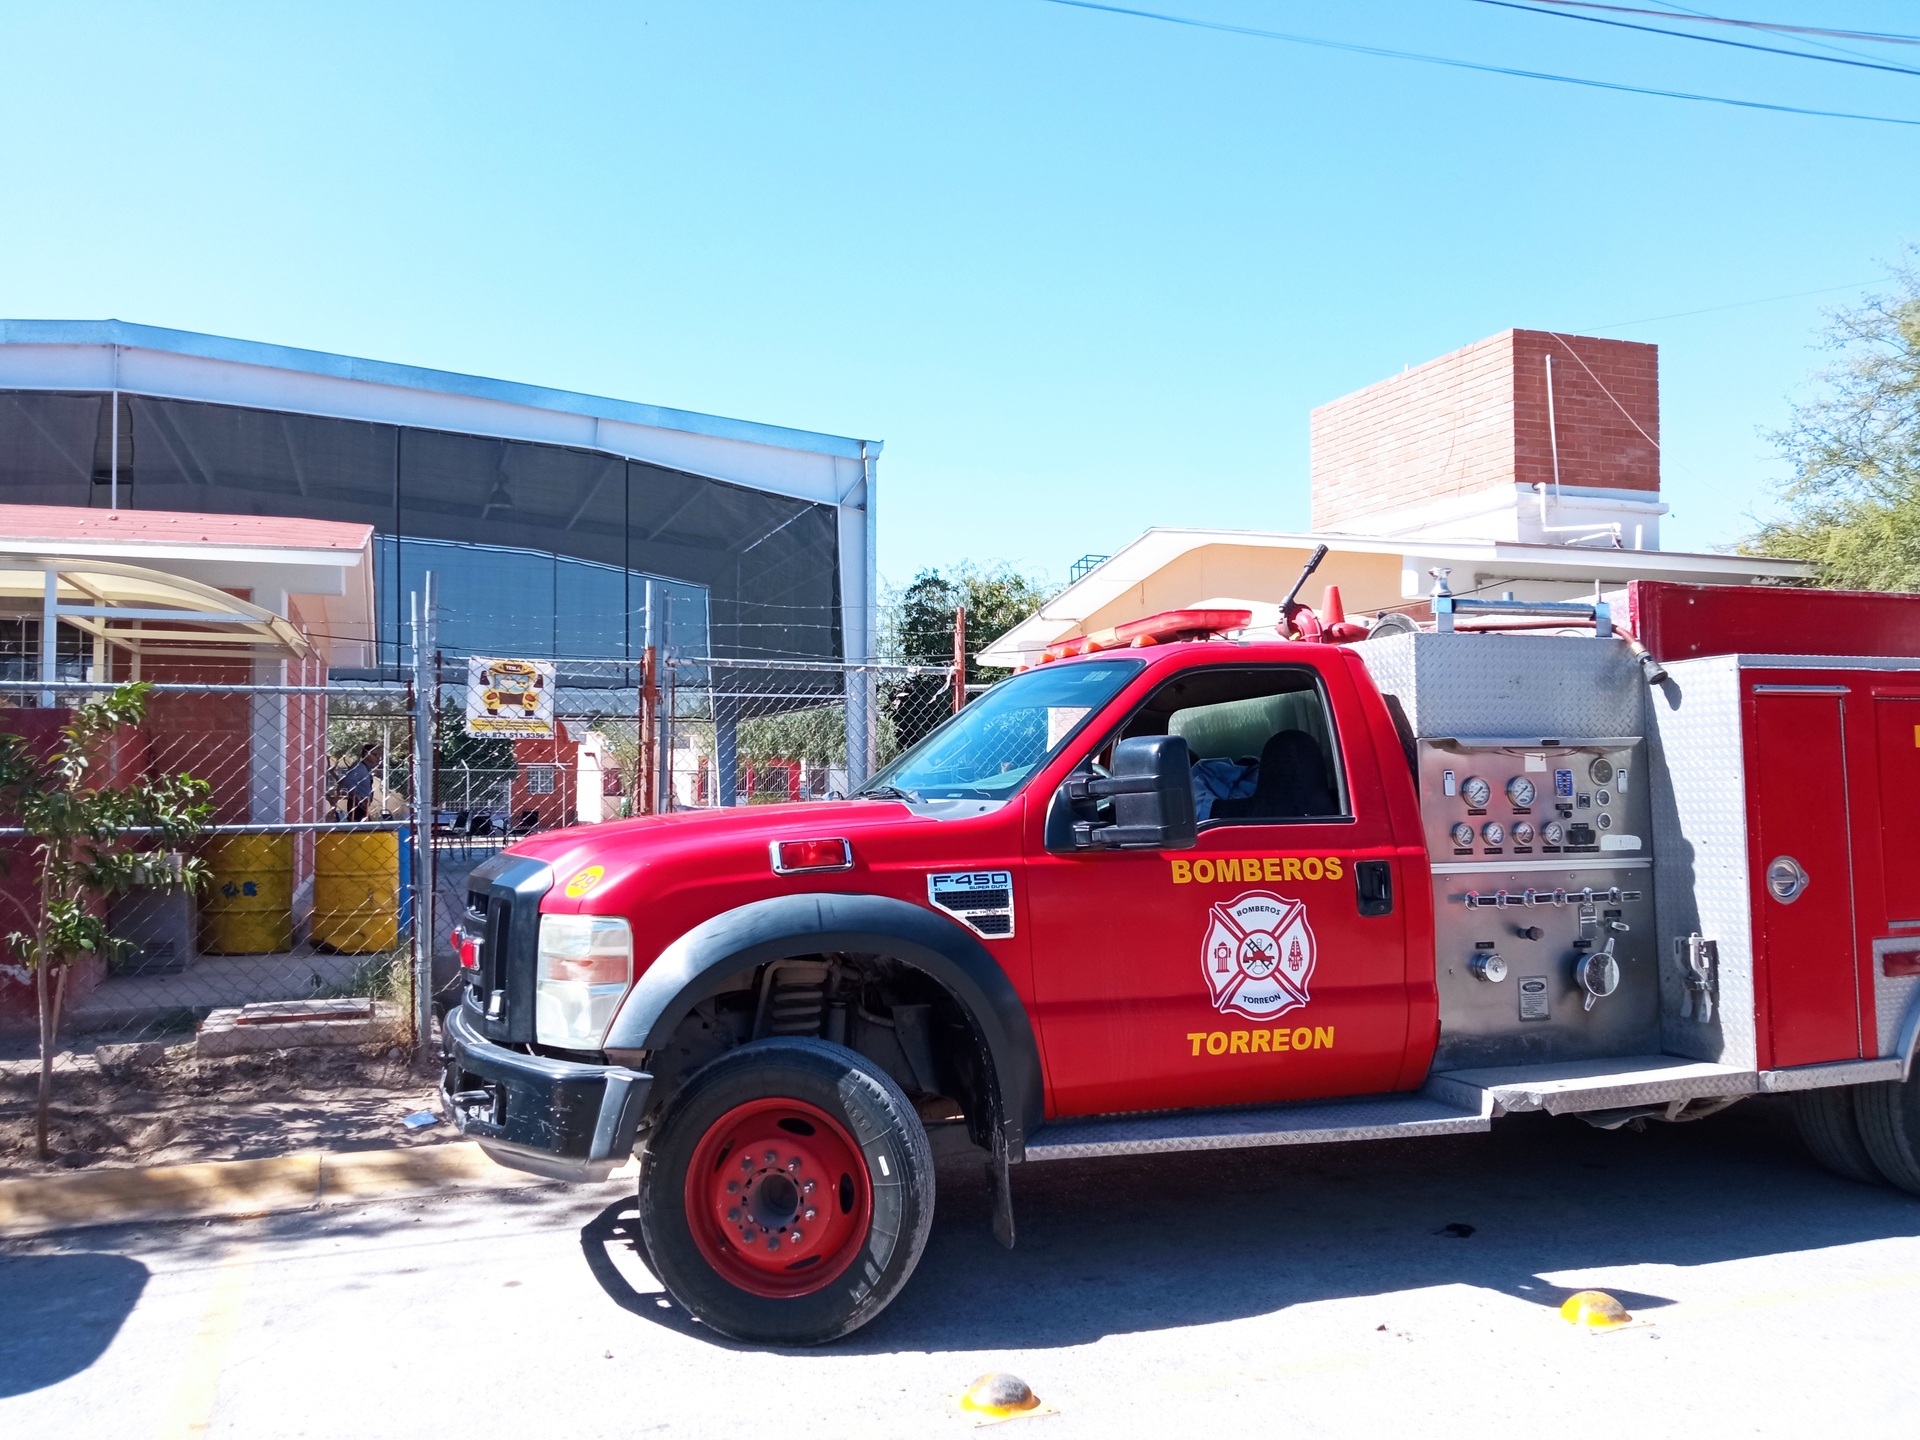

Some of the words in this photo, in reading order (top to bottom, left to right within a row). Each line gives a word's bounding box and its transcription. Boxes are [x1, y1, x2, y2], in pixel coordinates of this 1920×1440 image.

[1171, 857, 1344, 884] BOMBEROS
[570, 873, 597, 889] 29
[933, 873, 1008, 887] F-450
[1236, 905, 1281, 917] BOMBEROS
[1242, 992, 1281, 1004] TORREON
[1187, 1026, 1334, 1056] TORREON
